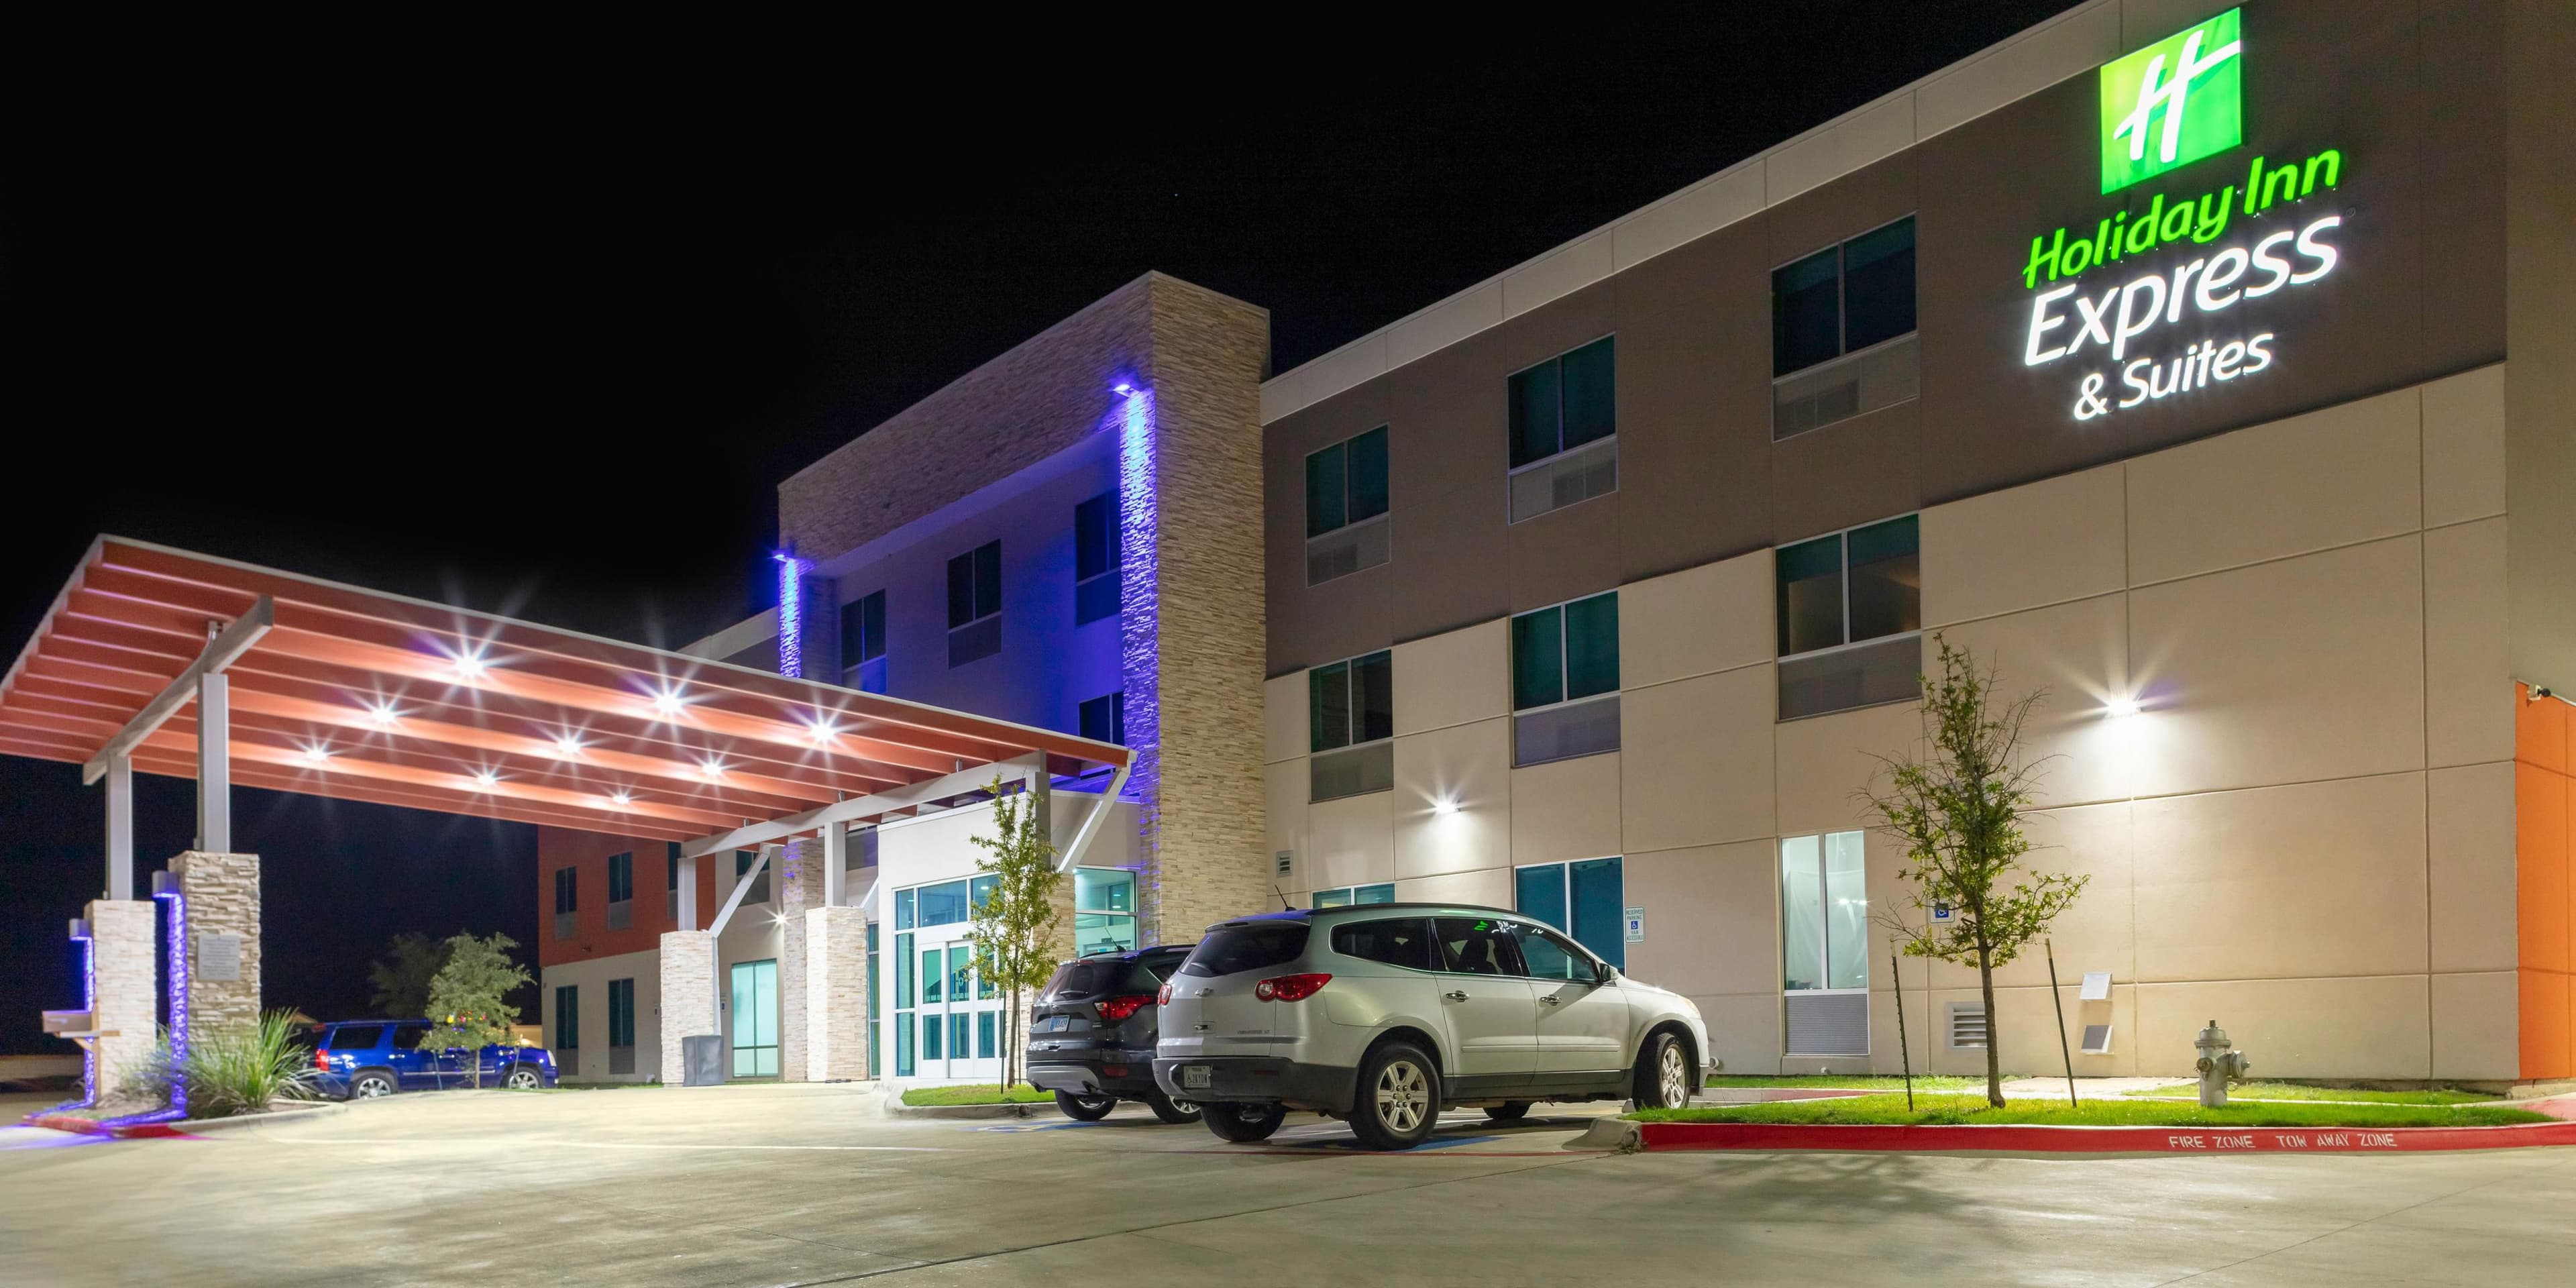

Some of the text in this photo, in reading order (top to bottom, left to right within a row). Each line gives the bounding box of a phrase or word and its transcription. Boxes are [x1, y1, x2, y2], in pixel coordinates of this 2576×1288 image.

[2023, 150, 2341, 288] Holiday Inn
[2025, 216, 2341, 366] Express
[2074, 333, 2274, 421] & Suites
[2169, 1134, 2398, 1148] FIRE ZONE TOW AWAY ZONE
